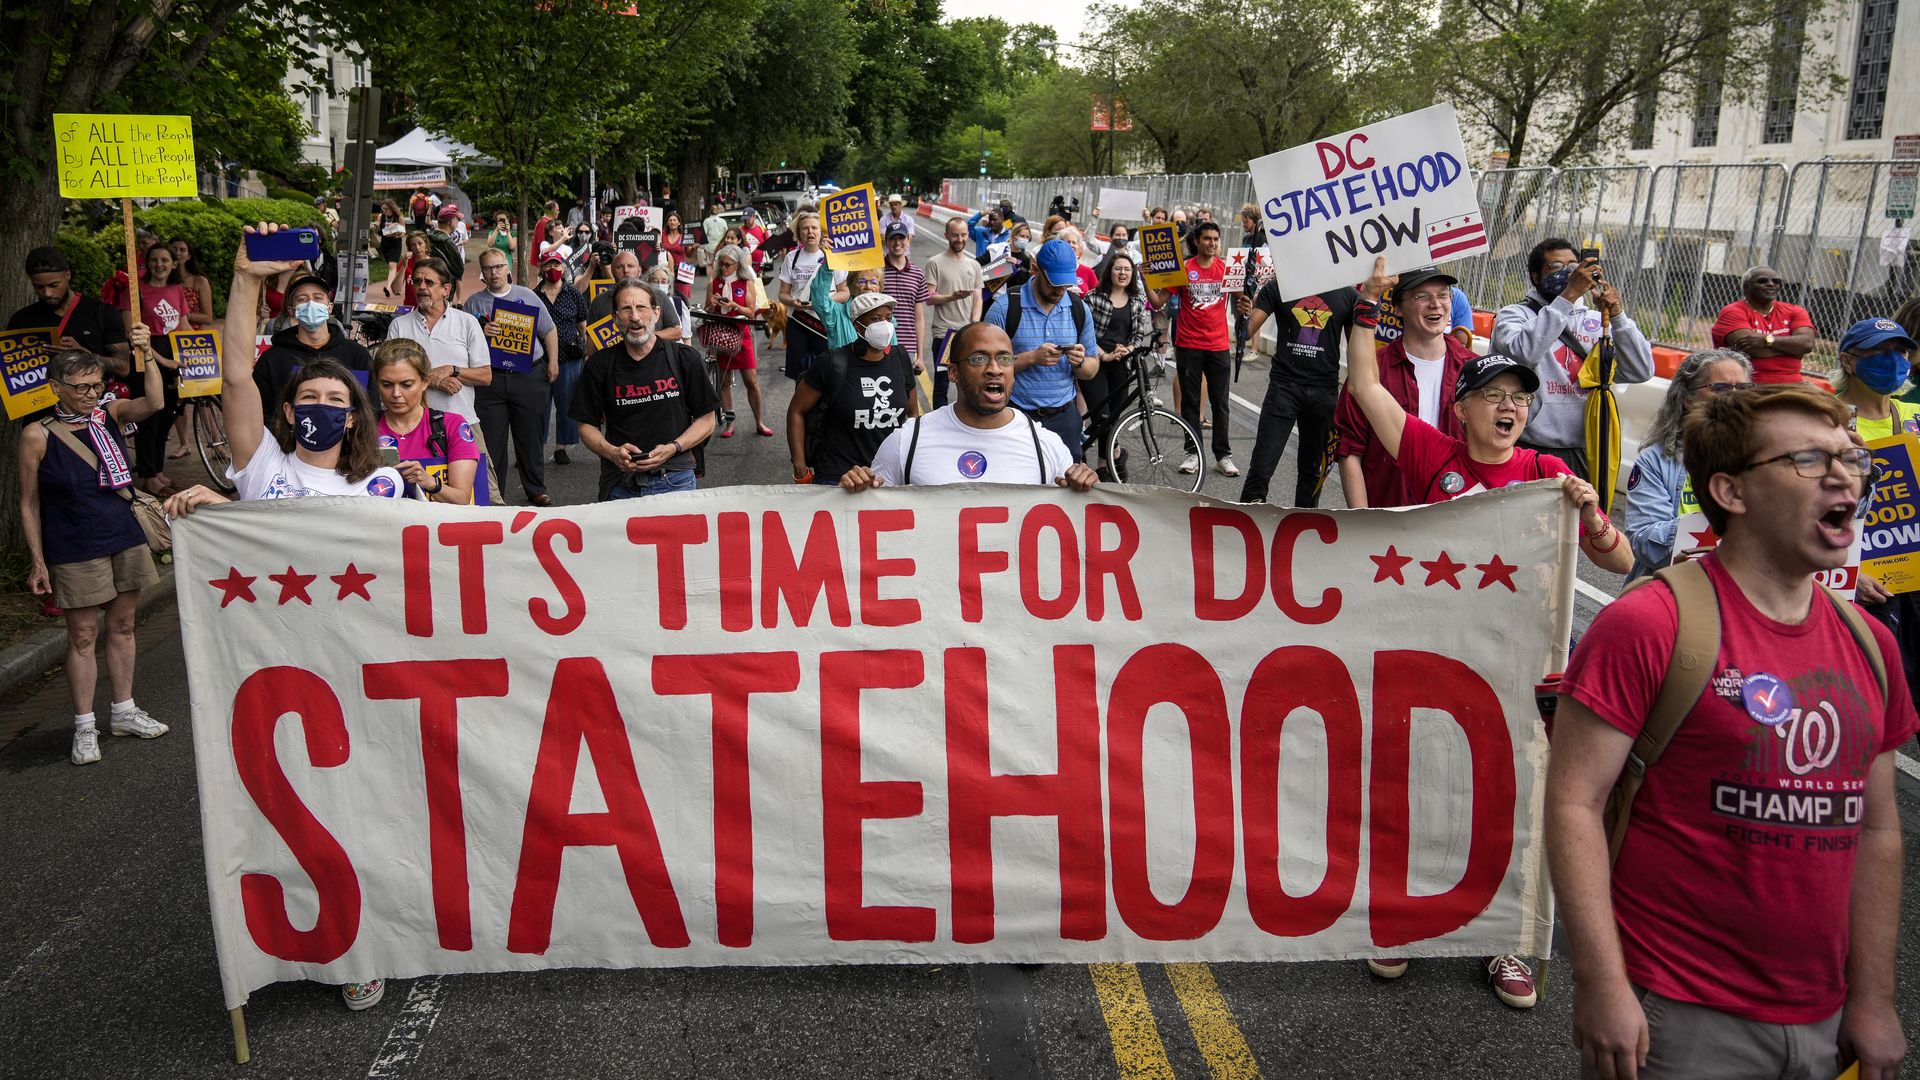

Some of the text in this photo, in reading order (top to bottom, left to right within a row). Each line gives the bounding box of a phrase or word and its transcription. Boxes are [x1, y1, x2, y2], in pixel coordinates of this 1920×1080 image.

[60, 122, 79, 143] of
[89, 122, 124, 143] ALL
[129, 124, 153, 142] the
[64, 146, 195, 168] by ALL the People
[1315, 133, 1375, 181] DC
[63, 167, 196, 188] for ALL the People
[829, 195, 865, 213] D.C.
[831, 210, 866, 223] STATE
[832, 222, 868, 235] HOOD
[1325, 207, 1421, 264] NOW
[834, 232, 869, 249] NOW
[1145, 231, 1171, 244] D.C.
[1148, 243, 1173, 253] STATE
[1149, 252, 1174, 262] HOOD
[1150, 260, 1176, 270] NOW
[179, 337, 212, 348] D.C.
[494, 335, 529, 352] VOTE
[183, 347, 214, 357] STATE
[6, 355, 50, 376] HOOD
[183, 357, 216, 367] HOOD
[1476, 355, 1506, 368] FREE
[184, 366, 216, 377] NOW
[616, 377, 679, 399] I Am DC
[860, 375, 894, 398] DC
[621, 396, 652, 406] Demand
[652, 393, 665, 401] the
[872, 396, 891, 410] AS
[854, 408, 905, 430] FUCK
[1863, 503, 1916, 527] OOD
[625, 510, 921, 628] TIME
[958, 503, 1142, 621] FOR
[1189, 505, 1343, 625] DC
[1872, 556, 1910, 567] PFAW.ORG
[1779, 778, 1834, 791] WORLD
[231, 643, 1517, 965] STATEHOOD
[1725, 825, 1795, 850] FIGHT
